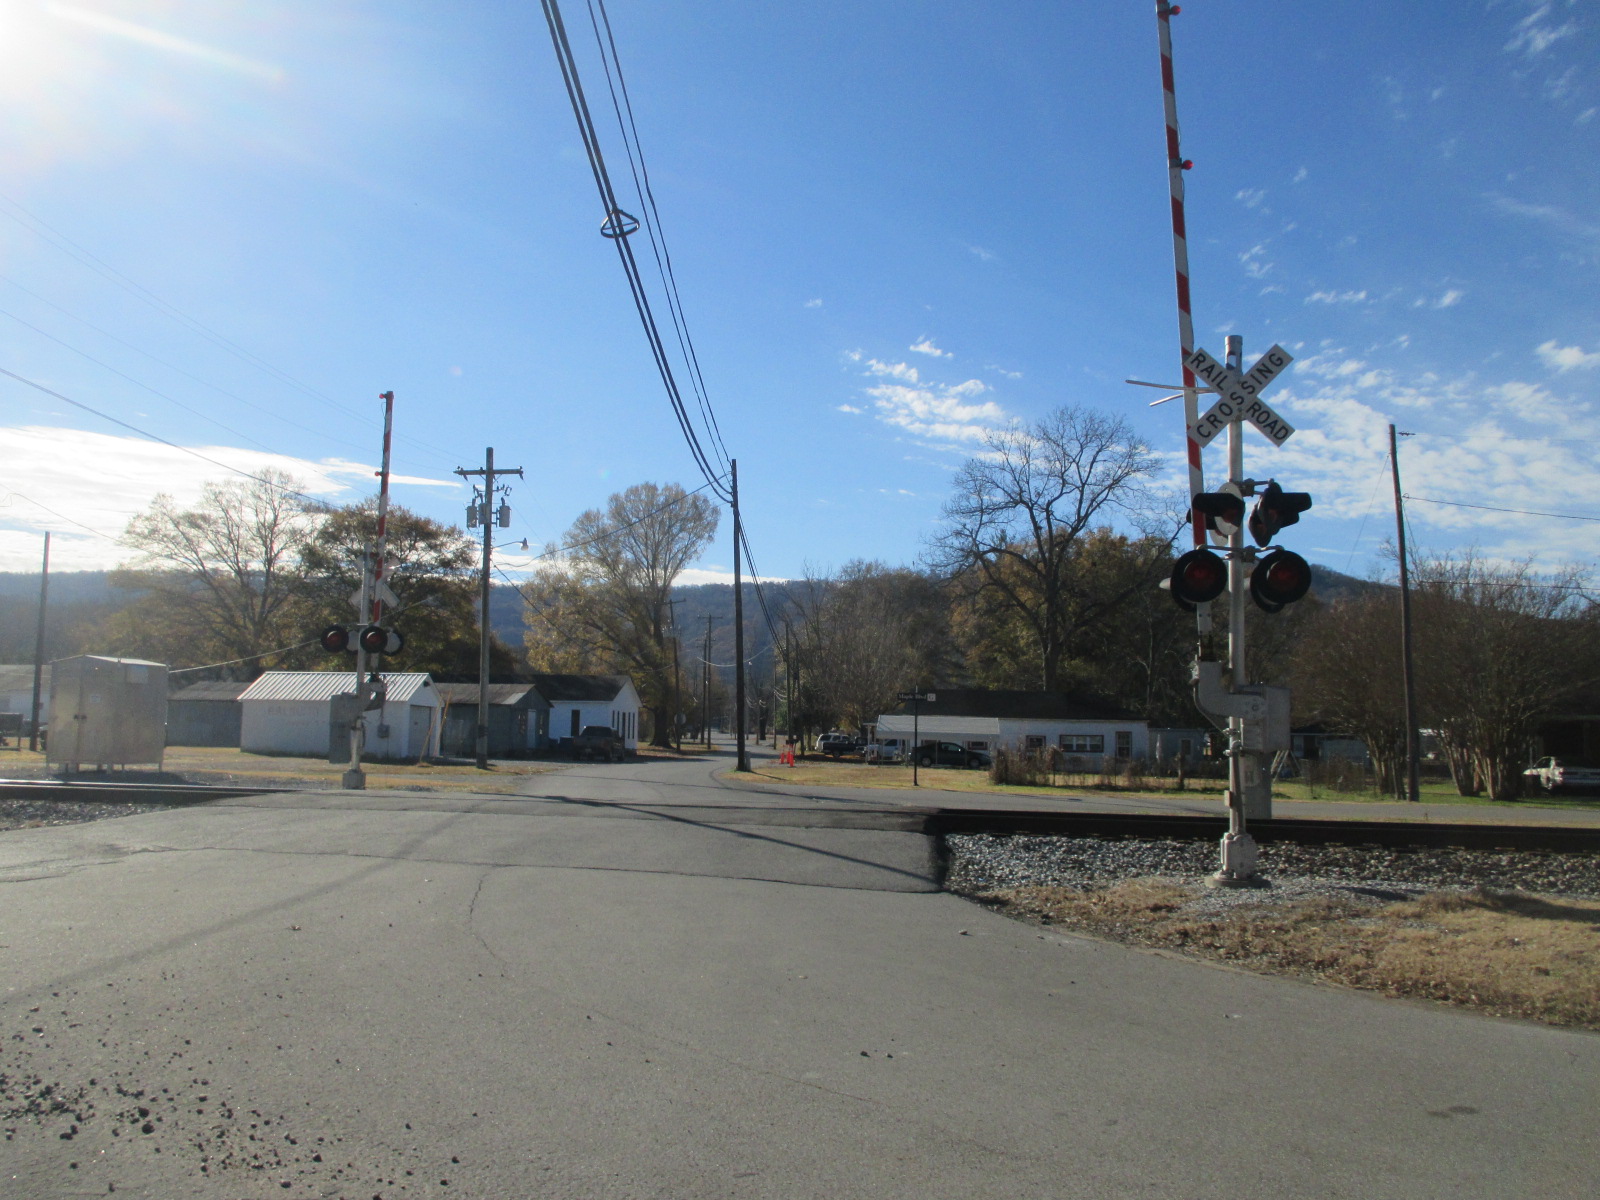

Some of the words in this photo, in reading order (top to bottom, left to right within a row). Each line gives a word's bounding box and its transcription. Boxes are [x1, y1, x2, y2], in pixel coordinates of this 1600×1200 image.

[1190, 353, 1228, 391] RAIL
[1246, 402, 1289, 440] ROAD
[1196, 353, 1284, 438] CROSSING
